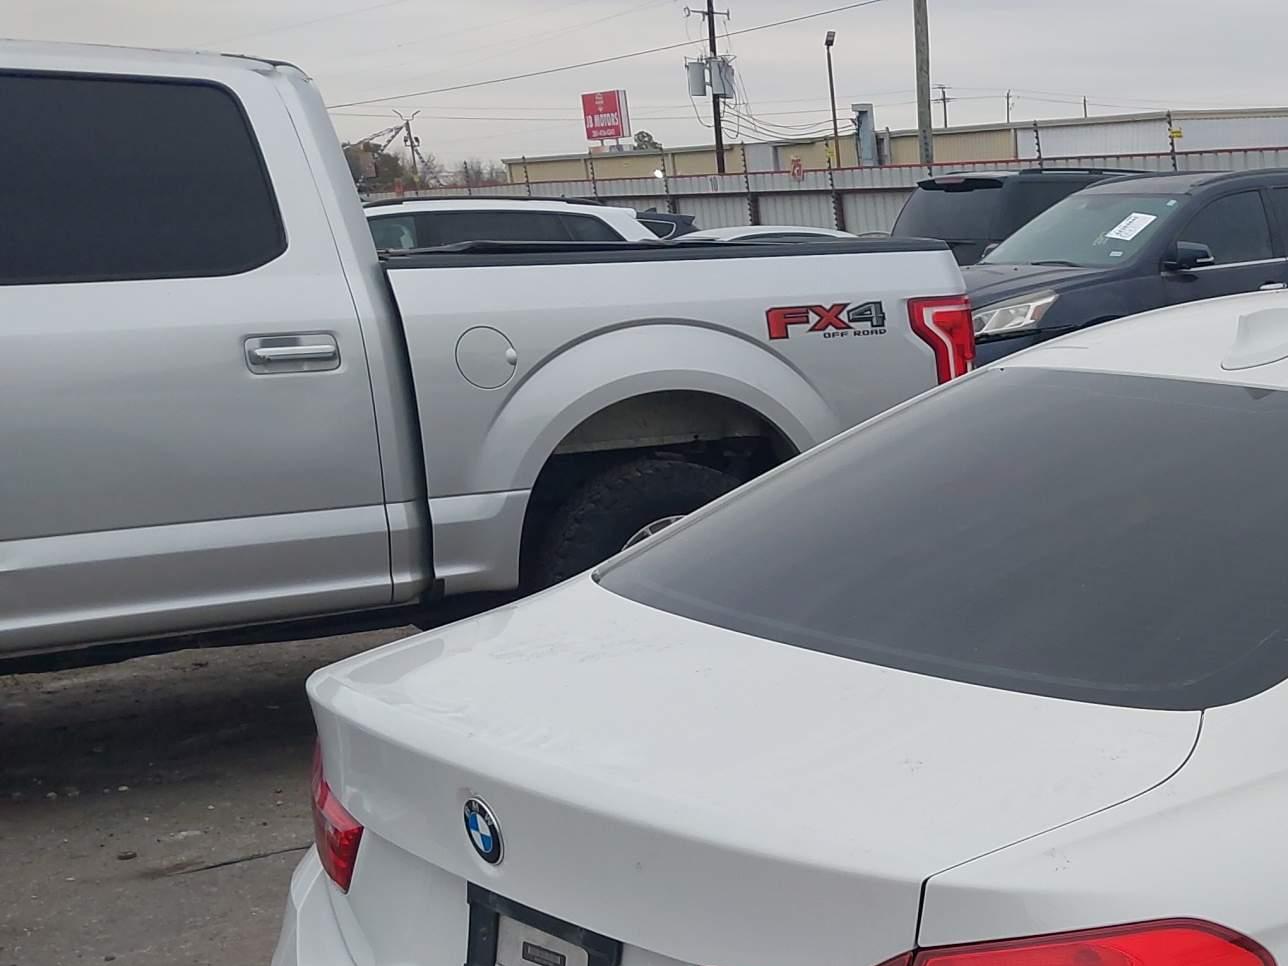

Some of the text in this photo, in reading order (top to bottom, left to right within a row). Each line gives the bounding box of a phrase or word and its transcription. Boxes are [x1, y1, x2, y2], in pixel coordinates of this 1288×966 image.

[594, 112, 618, 127] MOTORS
[766, 301, 885, 340] FX4
[823, 328, 887, 339] OFF ROAD
